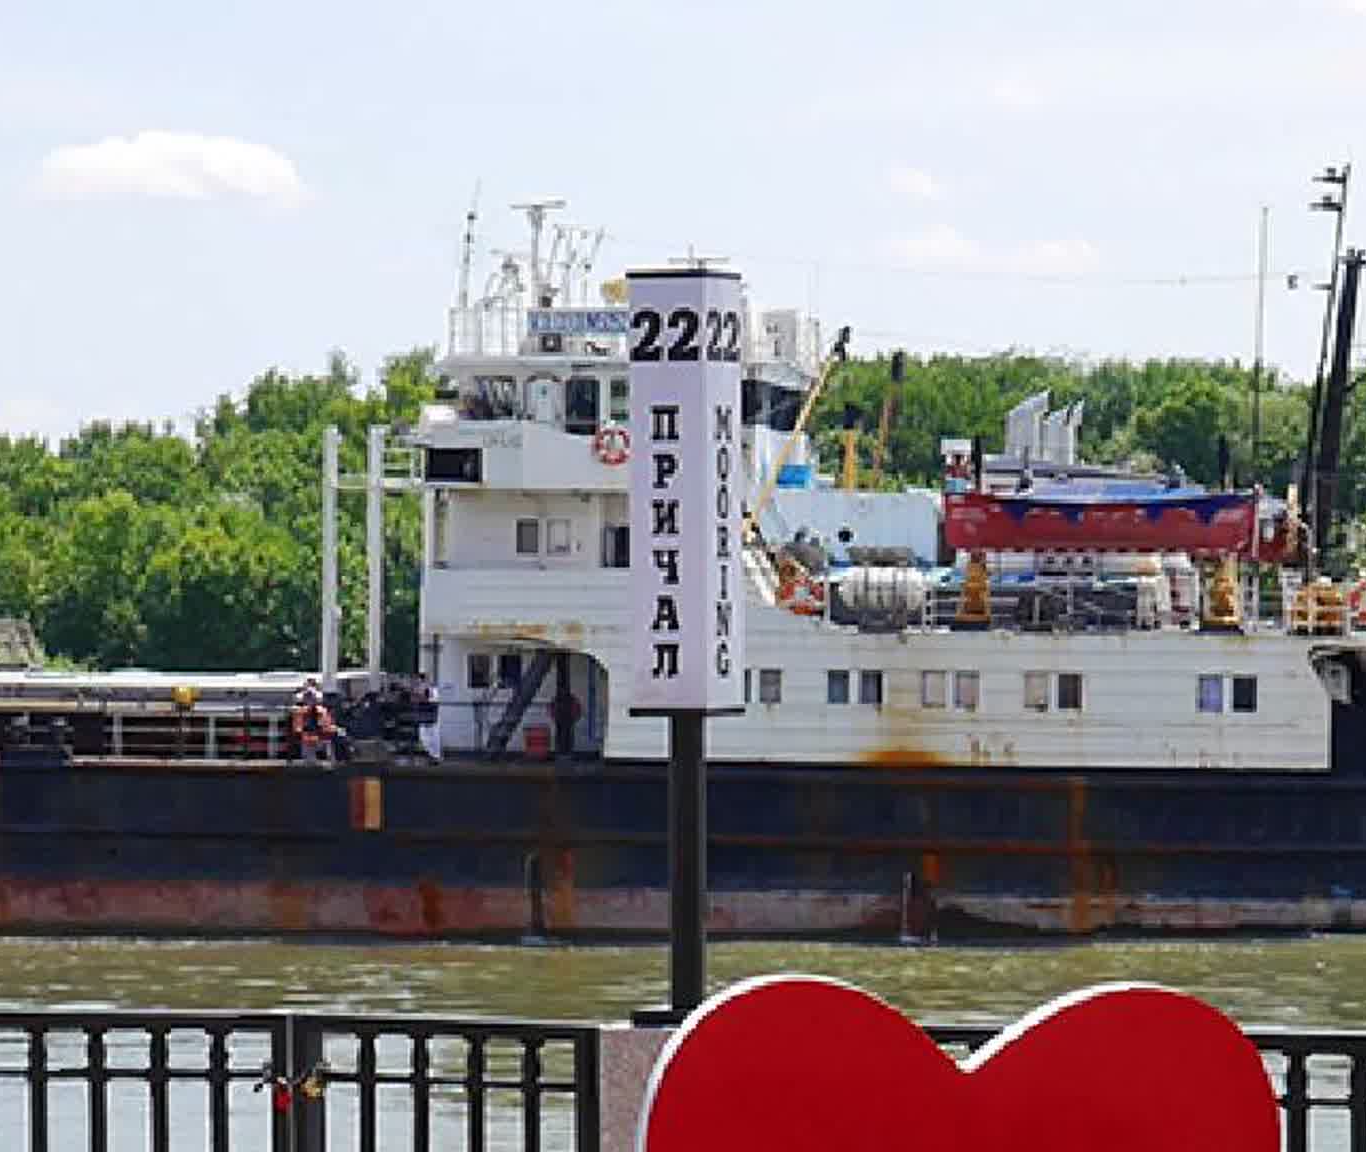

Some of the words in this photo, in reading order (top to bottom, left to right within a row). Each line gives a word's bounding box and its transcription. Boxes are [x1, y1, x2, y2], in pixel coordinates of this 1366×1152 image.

[629, 307, 701, 363] 22
[706, 309, 742, 363] 22
[650, 404, 681, 680] ПРИЧАЛ
[714, 404, 733, 680] MOORING
